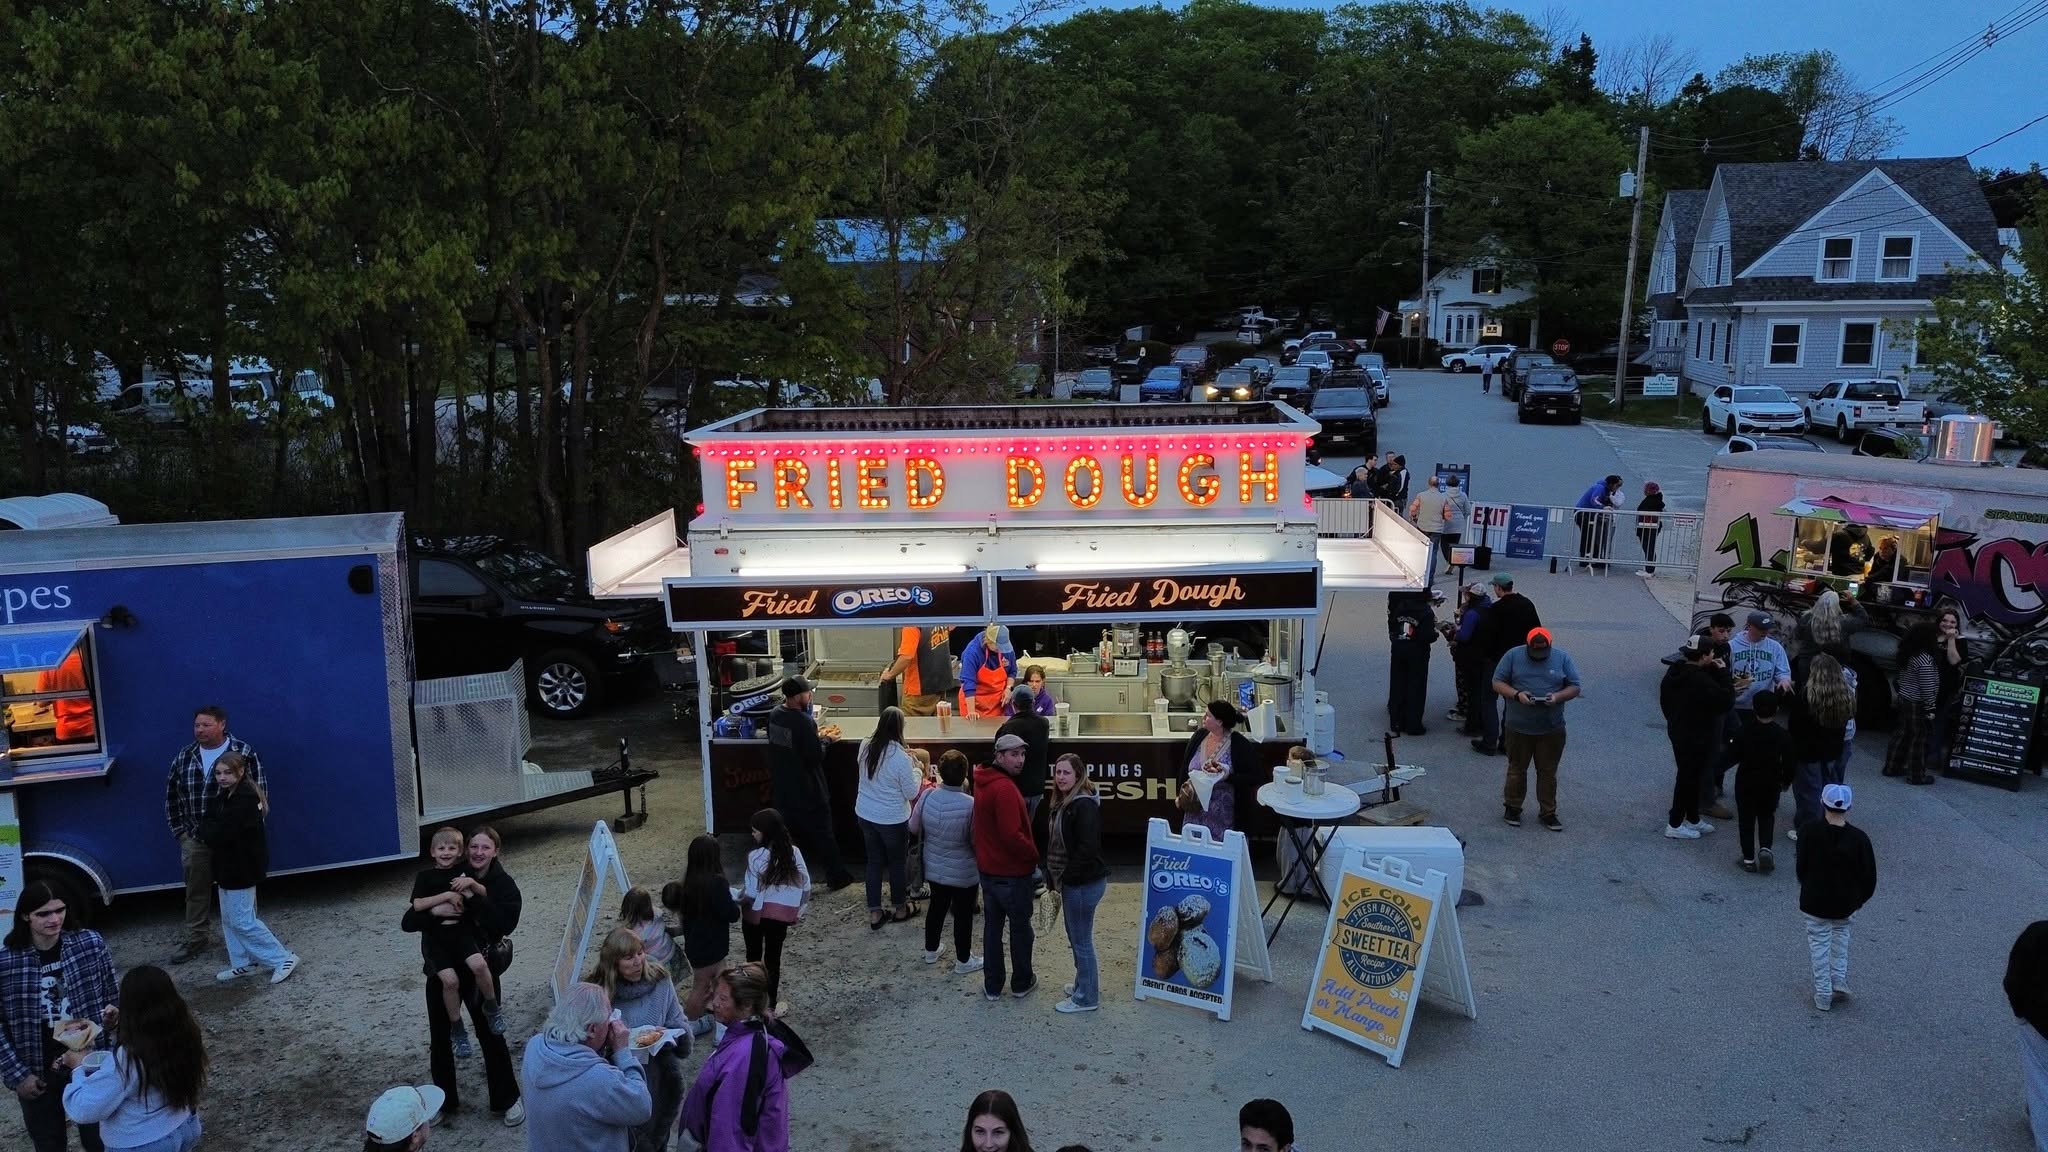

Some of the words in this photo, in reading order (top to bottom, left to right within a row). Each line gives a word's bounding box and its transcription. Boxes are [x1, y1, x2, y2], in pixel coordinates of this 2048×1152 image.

[1554, 343, 1568, 351] STOP
[726, 457, 946, 509] FRIED
[1005, 451, 1278, 508] DOUGH
[1473, 507, 1508, 527] EXIT
[0, 585, 72, 624] pes
[741, 589, 819, 618] Fried
[1061, 581, 1141, 611] Fried
[1149, 576, 1246, 609] Dough
[1734, 649, 1773, 662] BOSTON
[729, 693, 769, 714] OREO
[1048, 763, 1143, 778] TPINGS
[1151, 854, 1191, 871] Fried
[1341, 887, 1373, 909] ICE
[1378, 888, 1422, 931] COLD
[1352, 901, 1379, 921] FRESH
[1380, 902, 1409, 934] BREWED
[1361, 917, 1396, 934] Southern
[1342, 928, 1385, 955] SWEET
[1387, 939, 1410, 961] TEA
[1346, 959, 1358, 976] ALL
[1359, 969, 1398, 985] NATURAL
[1360, 953, 1387, 969] Recipe
[1142, 978, 1165, 990] CREDIT
[1166, 984, 1188, 996] CARDS
[1321, 978, 1357, 1001] Add
[1356, 991, 1400, 1018] Peach
[1317, 997, 1331, 1009] or
[1333, 1000, 1385, 1031] Mango
